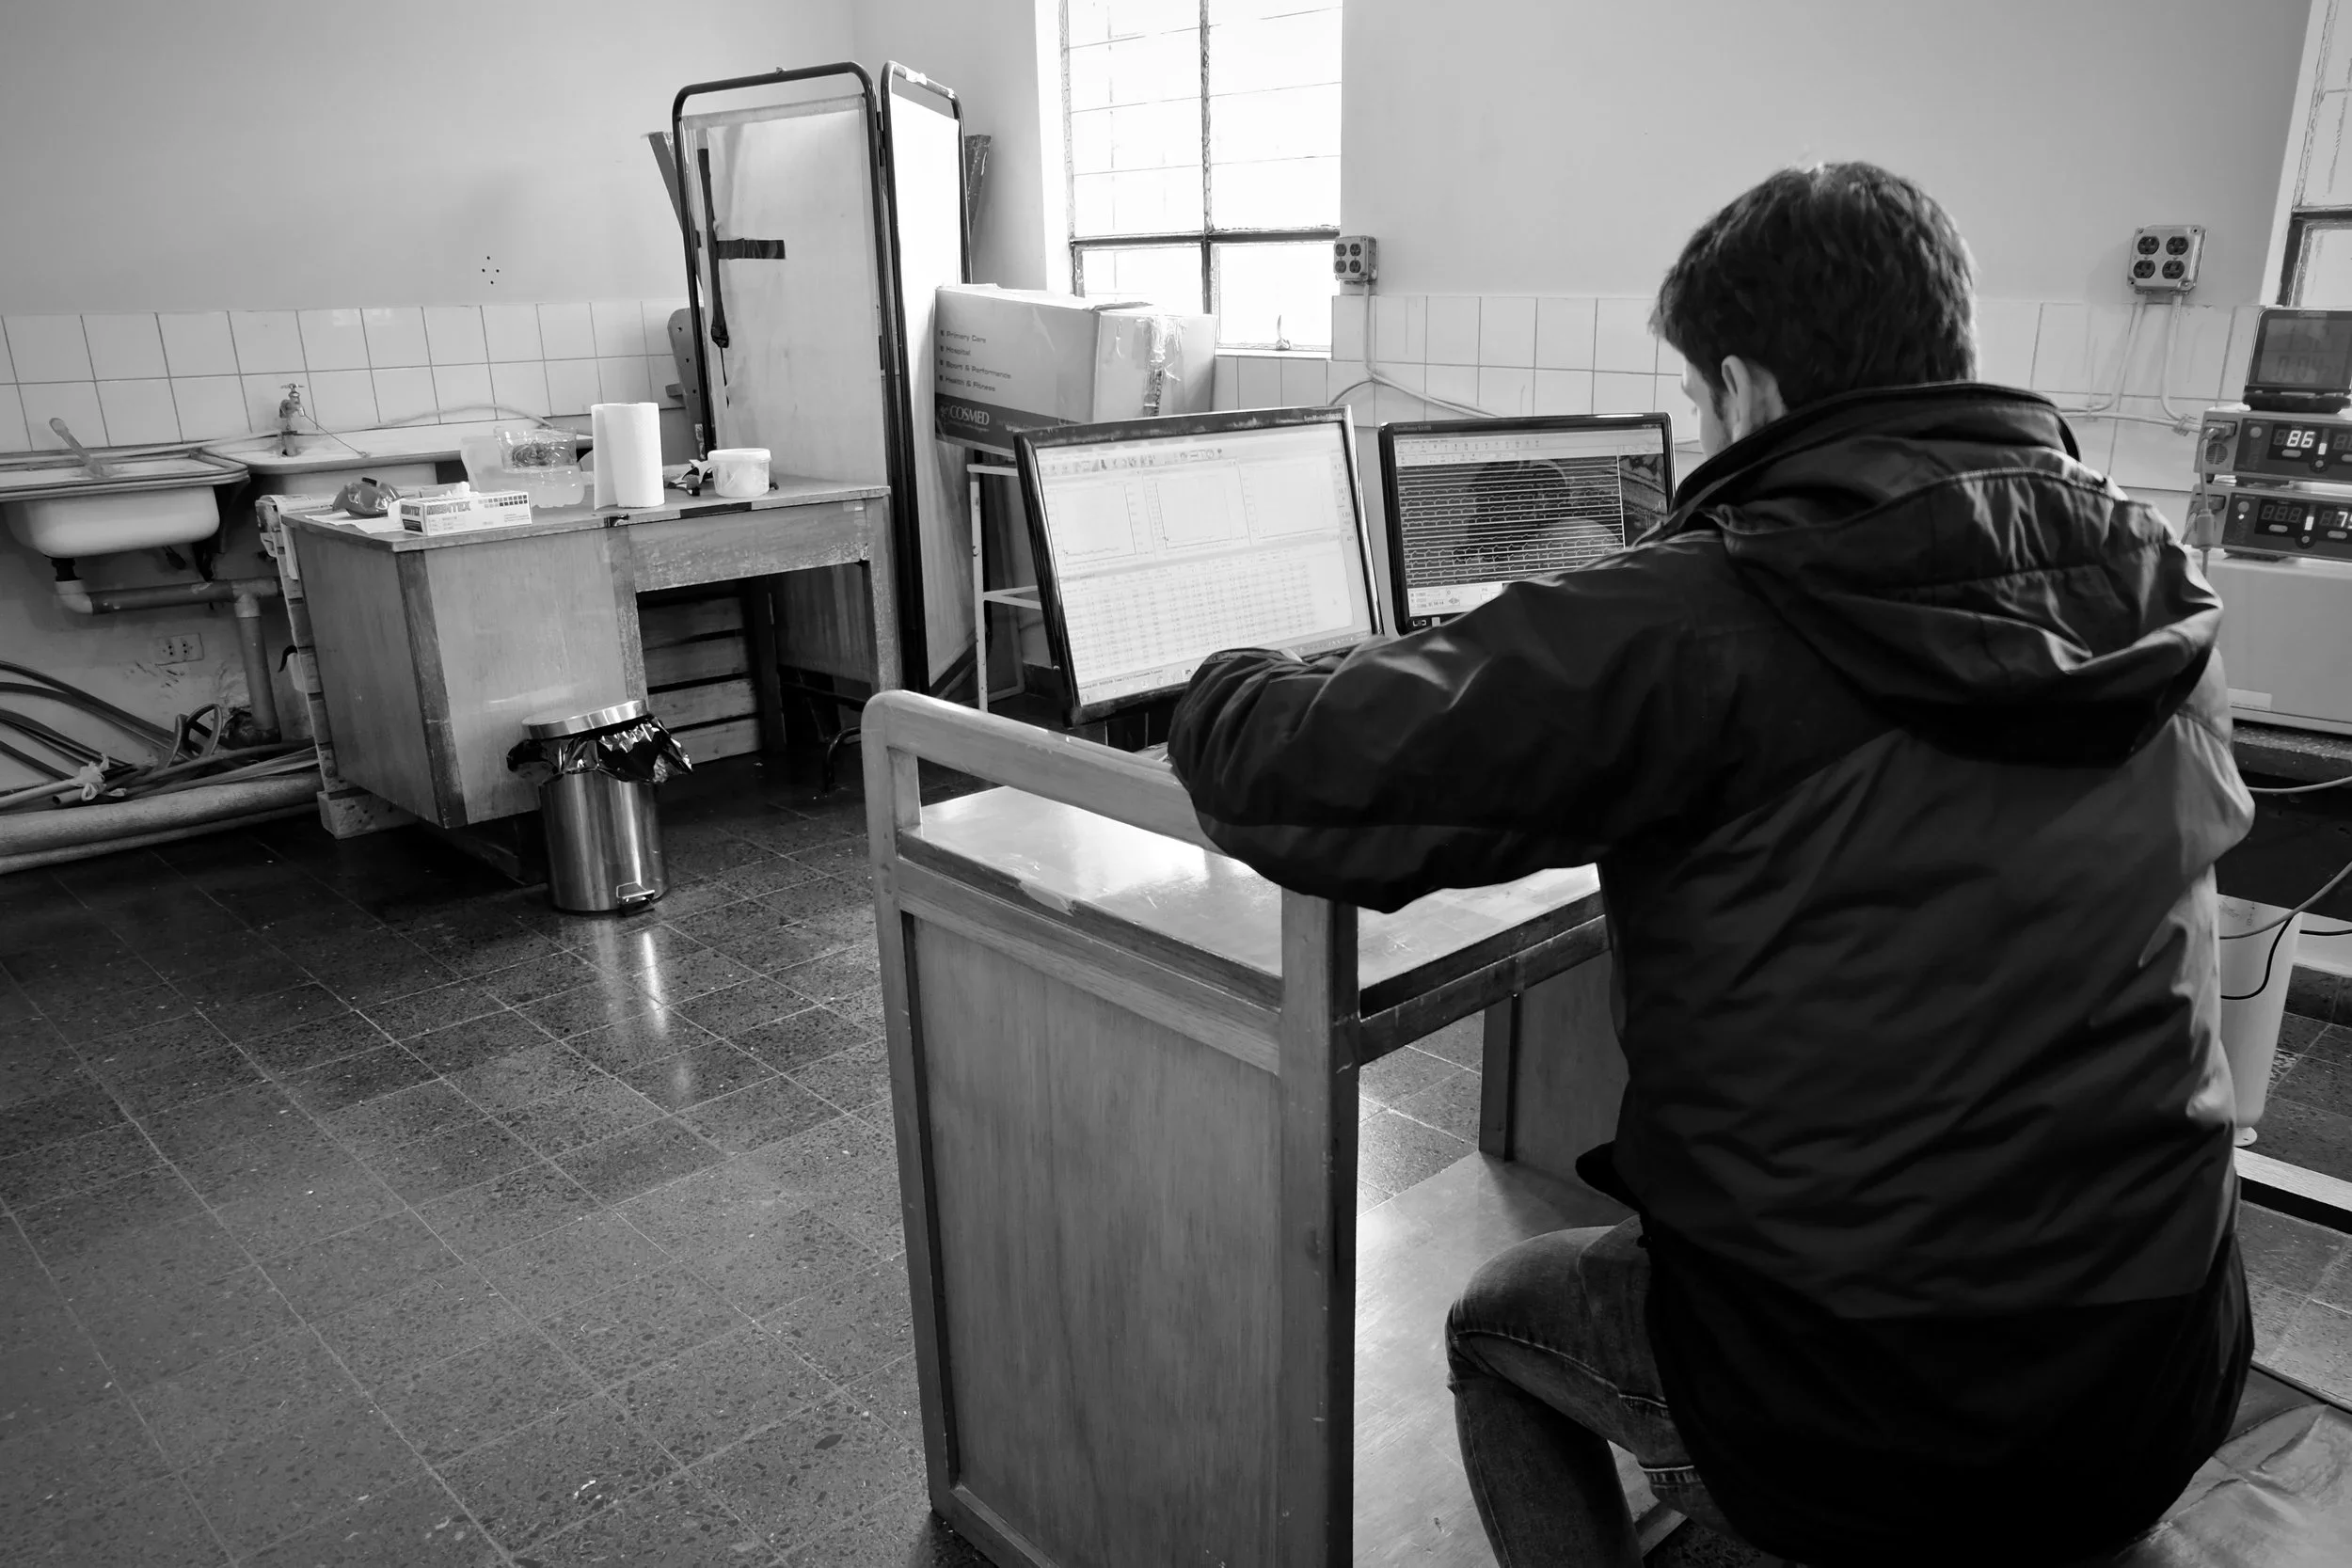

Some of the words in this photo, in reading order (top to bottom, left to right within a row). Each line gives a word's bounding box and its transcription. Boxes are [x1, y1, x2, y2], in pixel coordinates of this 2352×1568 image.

[946, 331, 970, 341] Primary
[972, 335, 986, 343] Care
[946, 346, 971, 356] Hospital
[946, 361, 963, 371] Sport
[972, 366, 1011, 379] Performance
[946, 376, 964, 386] Health
[973, 381, 995, 391] Fitness
[950, 405, 990, 426] COSMED
[2286, 430, 2315, 448] 86
